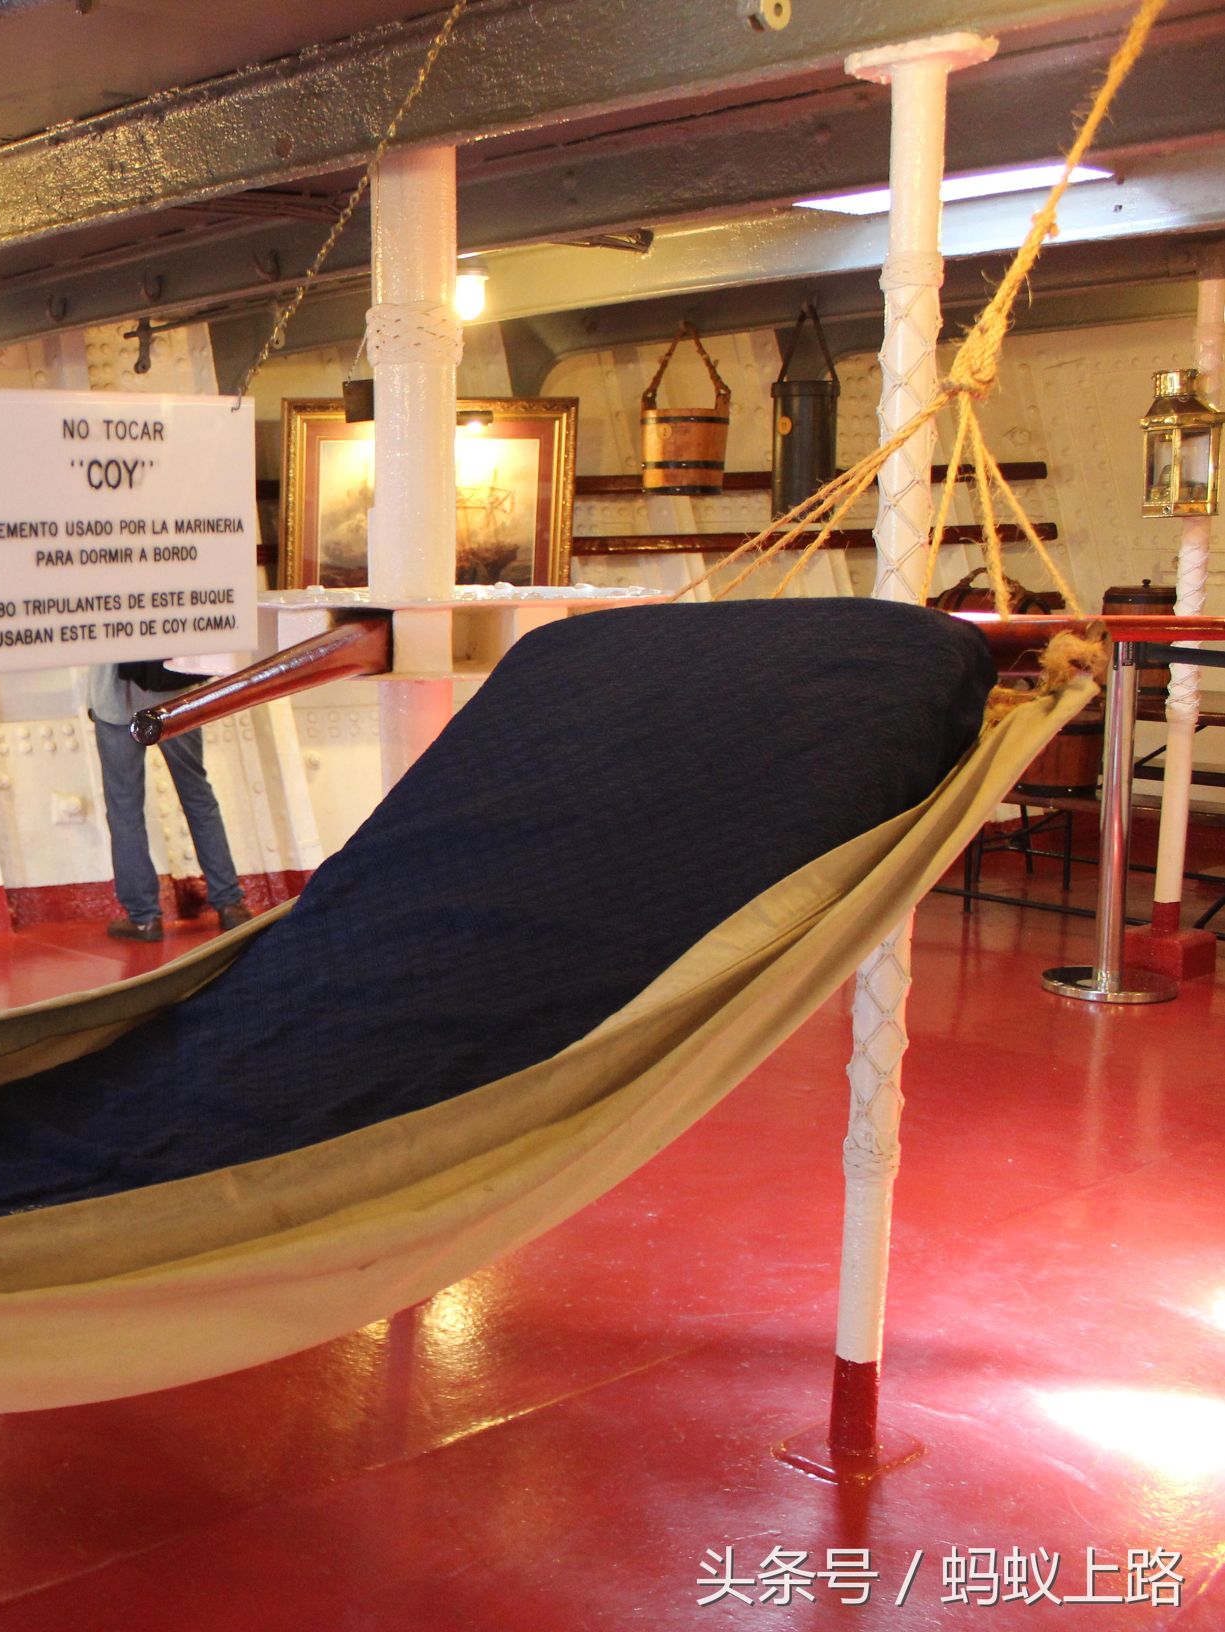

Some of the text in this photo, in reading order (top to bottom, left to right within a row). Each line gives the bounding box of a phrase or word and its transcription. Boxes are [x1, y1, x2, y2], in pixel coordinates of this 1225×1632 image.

[62, 419, 165, 440] NO TOCAR
[65, 521, 114, 537] USADO
[119, 520, 147, 534] POR
[151, 520, 169, 535] LA
[174, 518, 244, 534] MARINERIA
[35, 546, 198, 566] PARA DORMIR A BORDO
[21, 595, 123, 616] TRIPULANTES
[127, 594, 146, 609] DE
[150, 592, 185, 608] ESTE
[189, 589, 235, 606] BUQUE
[60, 624, 97, 642] ESTE
[102, 622, 134, 638] TIPO
[139, 620, 158, 636] DE
[161, 618, 188, 634] COY
